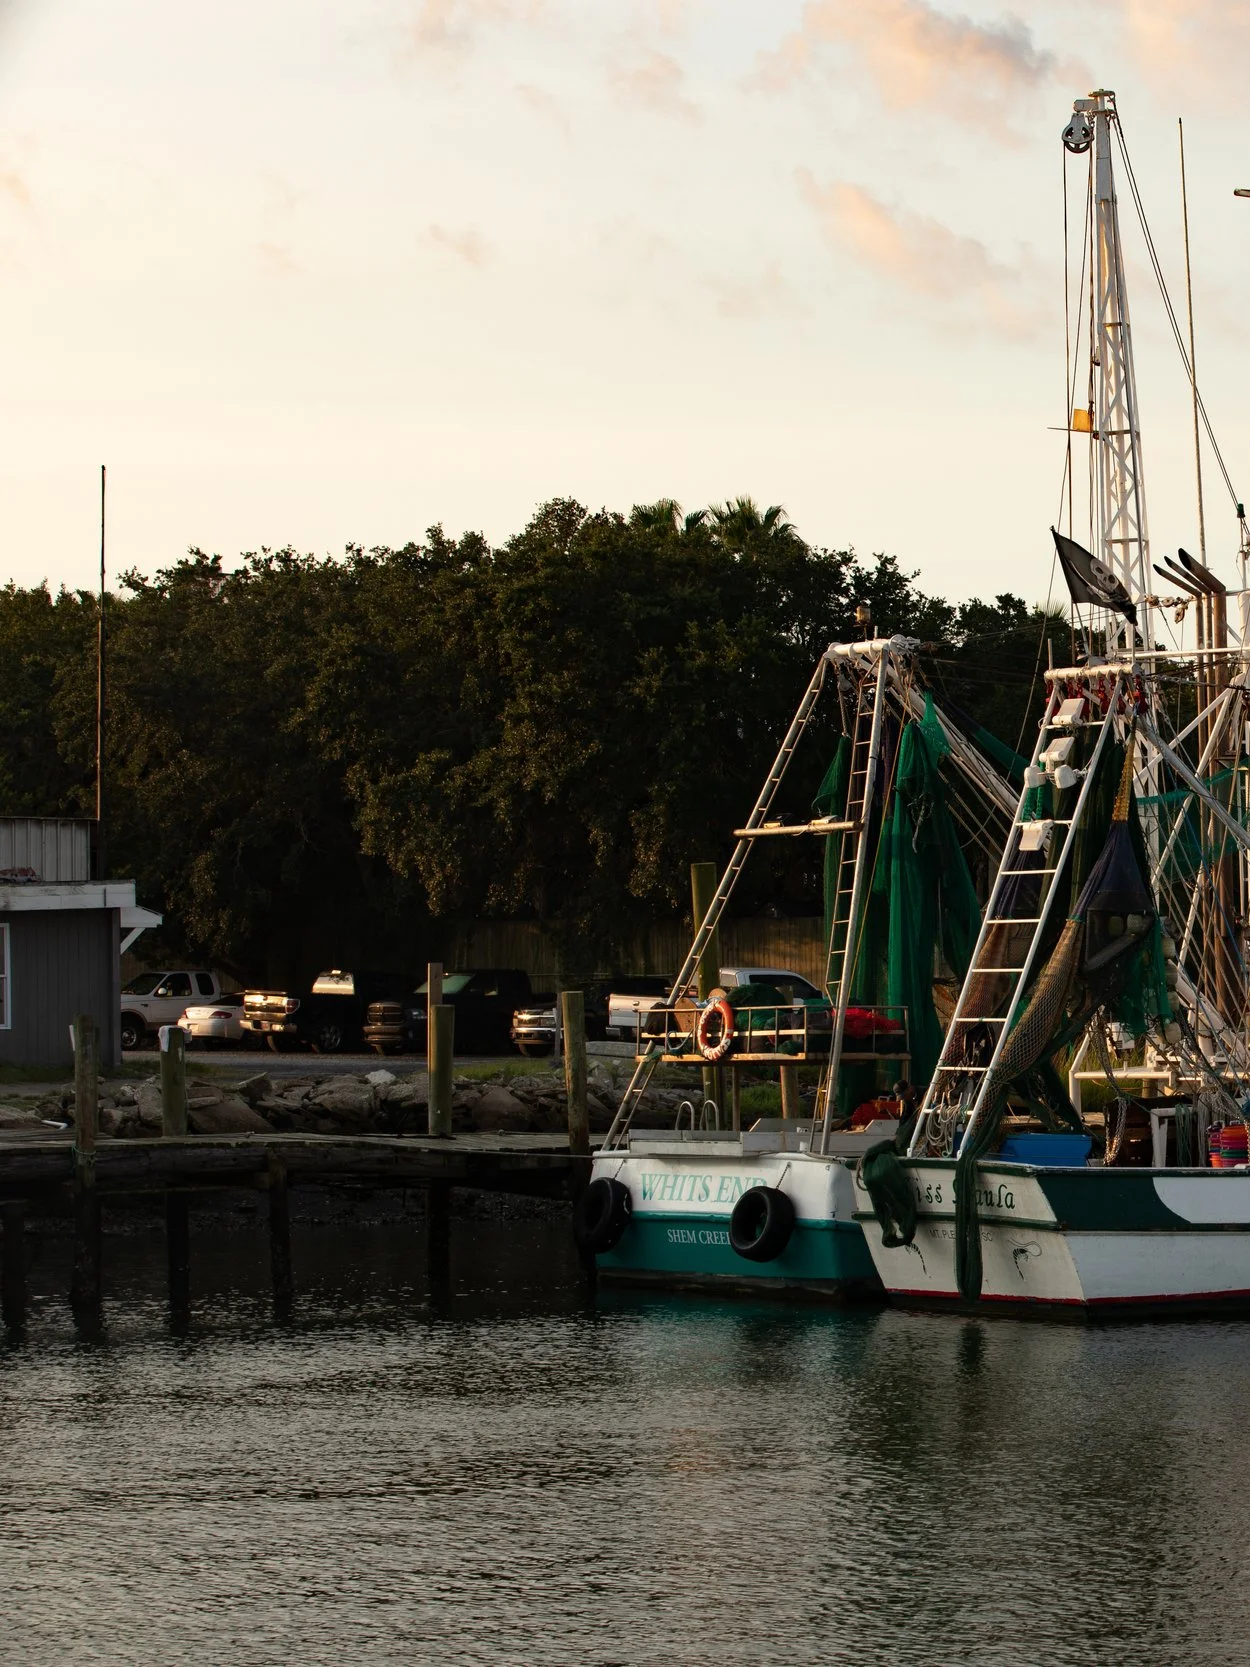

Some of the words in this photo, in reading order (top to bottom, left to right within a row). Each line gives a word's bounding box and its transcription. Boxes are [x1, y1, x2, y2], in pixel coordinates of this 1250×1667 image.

[640, 1173, 713, 1203] WHITS
[914, 1178, 943, 1204] iss
[667, 1229, 698, 1244] SHEM
